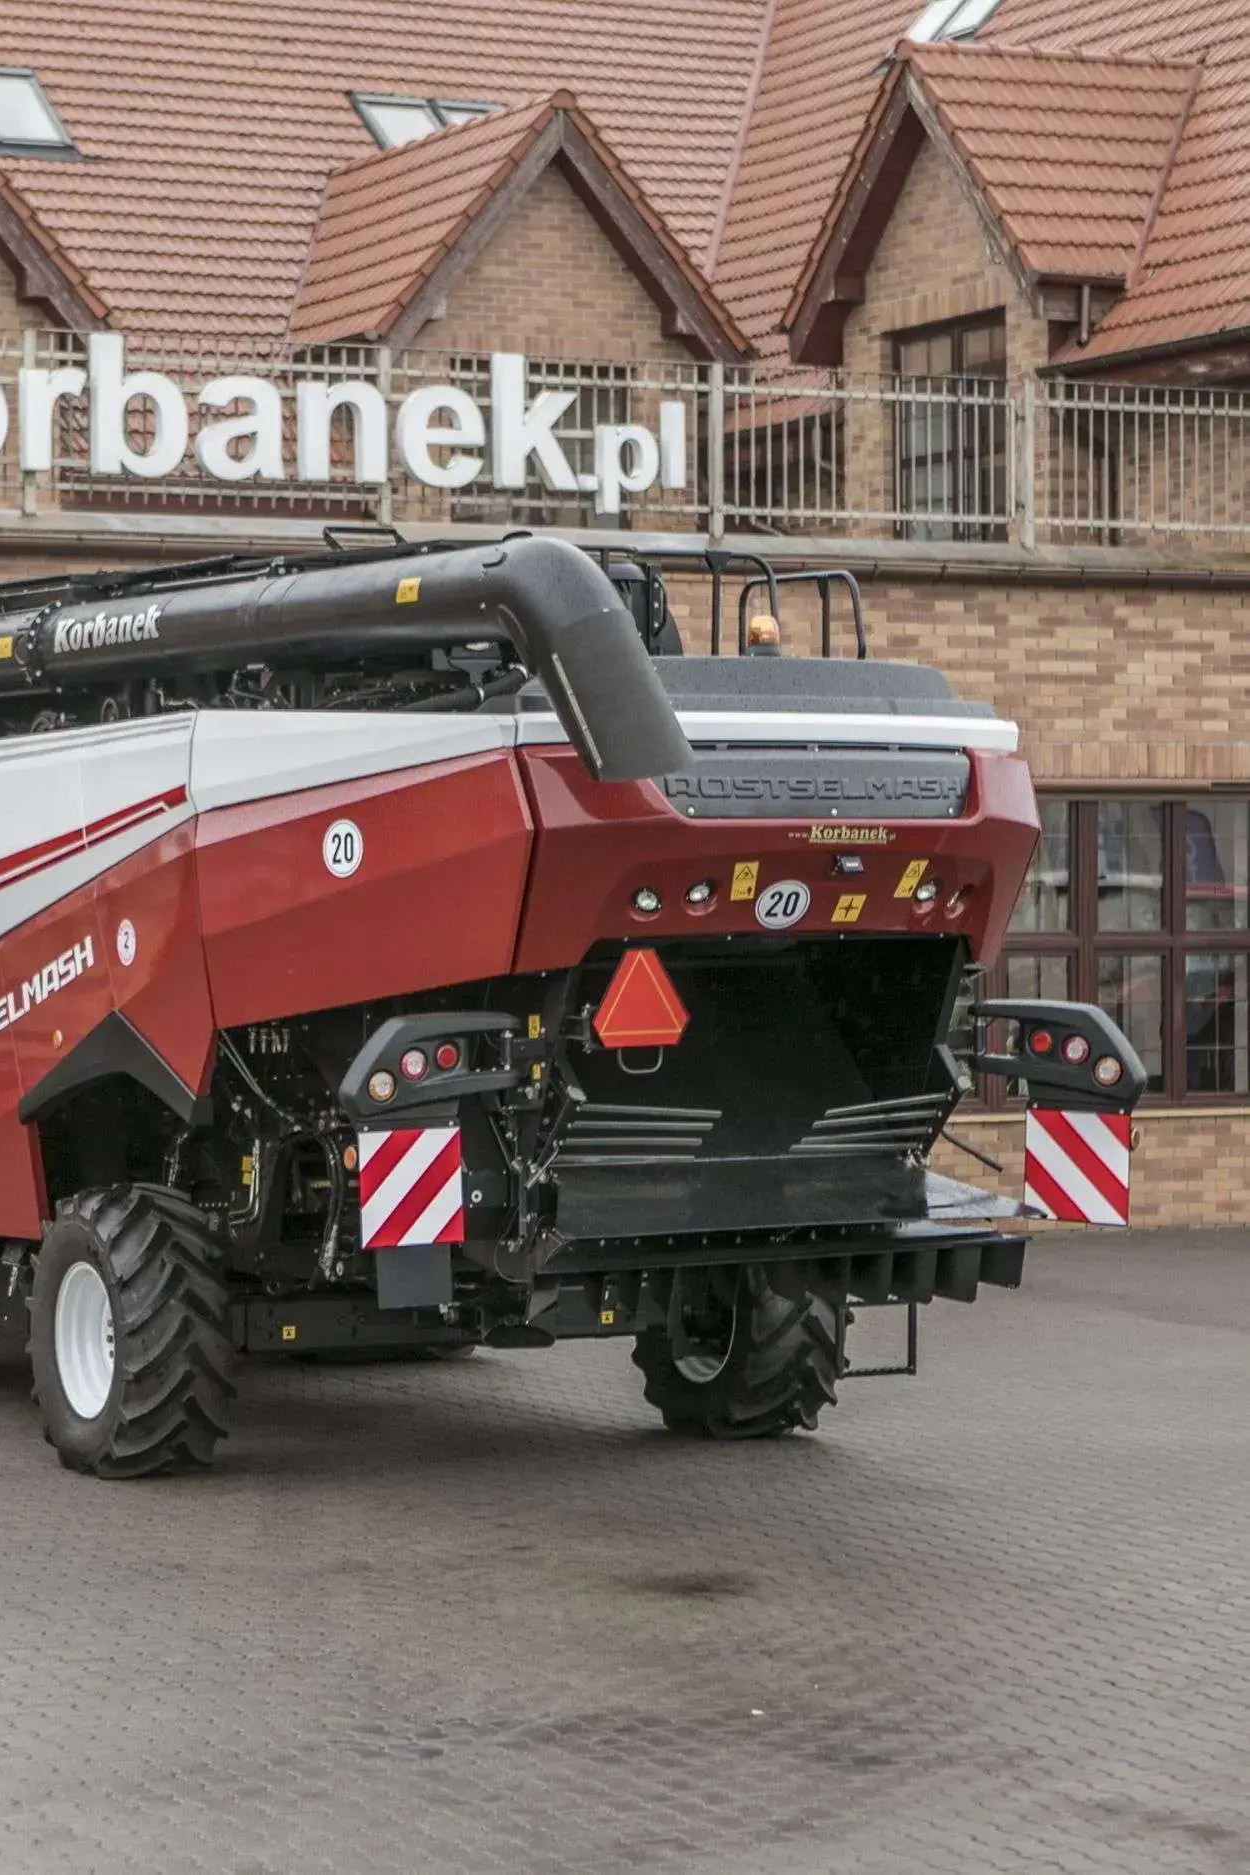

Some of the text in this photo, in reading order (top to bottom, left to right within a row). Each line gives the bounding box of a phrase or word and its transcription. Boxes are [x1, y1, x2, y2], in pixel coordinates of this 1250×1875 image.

[53, 604, 161, 653] Korbanek
[662, 775, 966, 800] ROSTSELMASH
[332, 832, 354, 864] 20
[764, 891, 800, 918] 20
